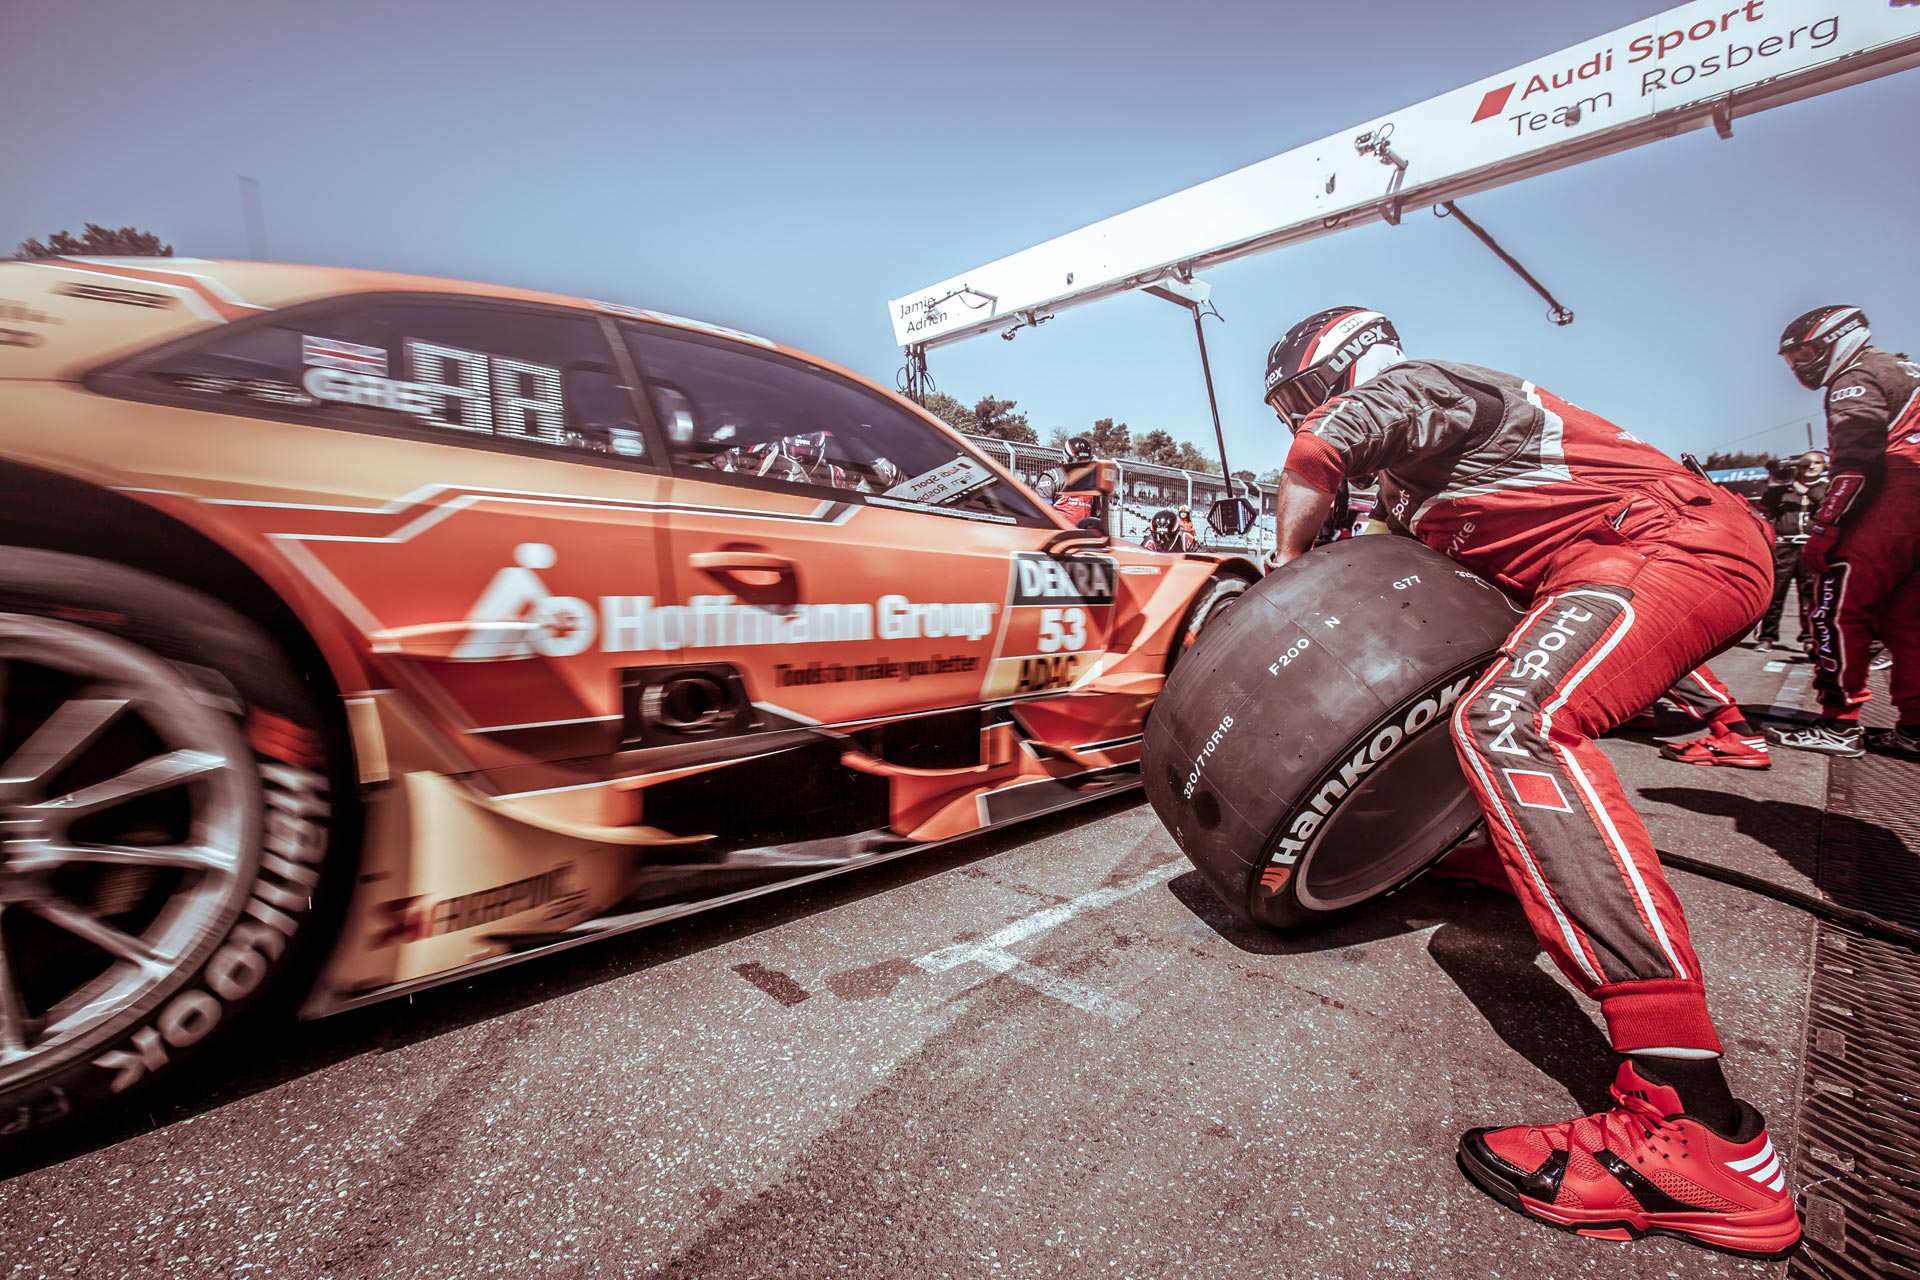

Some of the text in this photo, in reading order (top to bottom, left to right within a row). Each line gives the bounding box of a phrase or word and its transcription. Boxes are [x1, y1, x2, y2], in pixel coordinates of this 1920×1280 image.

[1520, 0, 1764, 100] Audi Sport
[1509, 15, 1839, 136] Team Rosberg
[900, 296, 936, 319] Jamie
[1328, 325, 1388, 372] uvex
[1823, 319, 1861, 343] uvex
[1265, 366, 1284, 387] vex
[1445, 521, 1476, 558] rvice
[1018, 560, 1112, 597] DEKRA
[600, 594, 993, 652] Hoffmann Group
[1037, 608, 1087, 653] 53
[1183, 715, 1234, 800] 320/710R18
[1324, 616, 1341, 629] N
[1392, 575, 1421, 590] G77
[1487, 606, 1593, 758] Audi Sport
